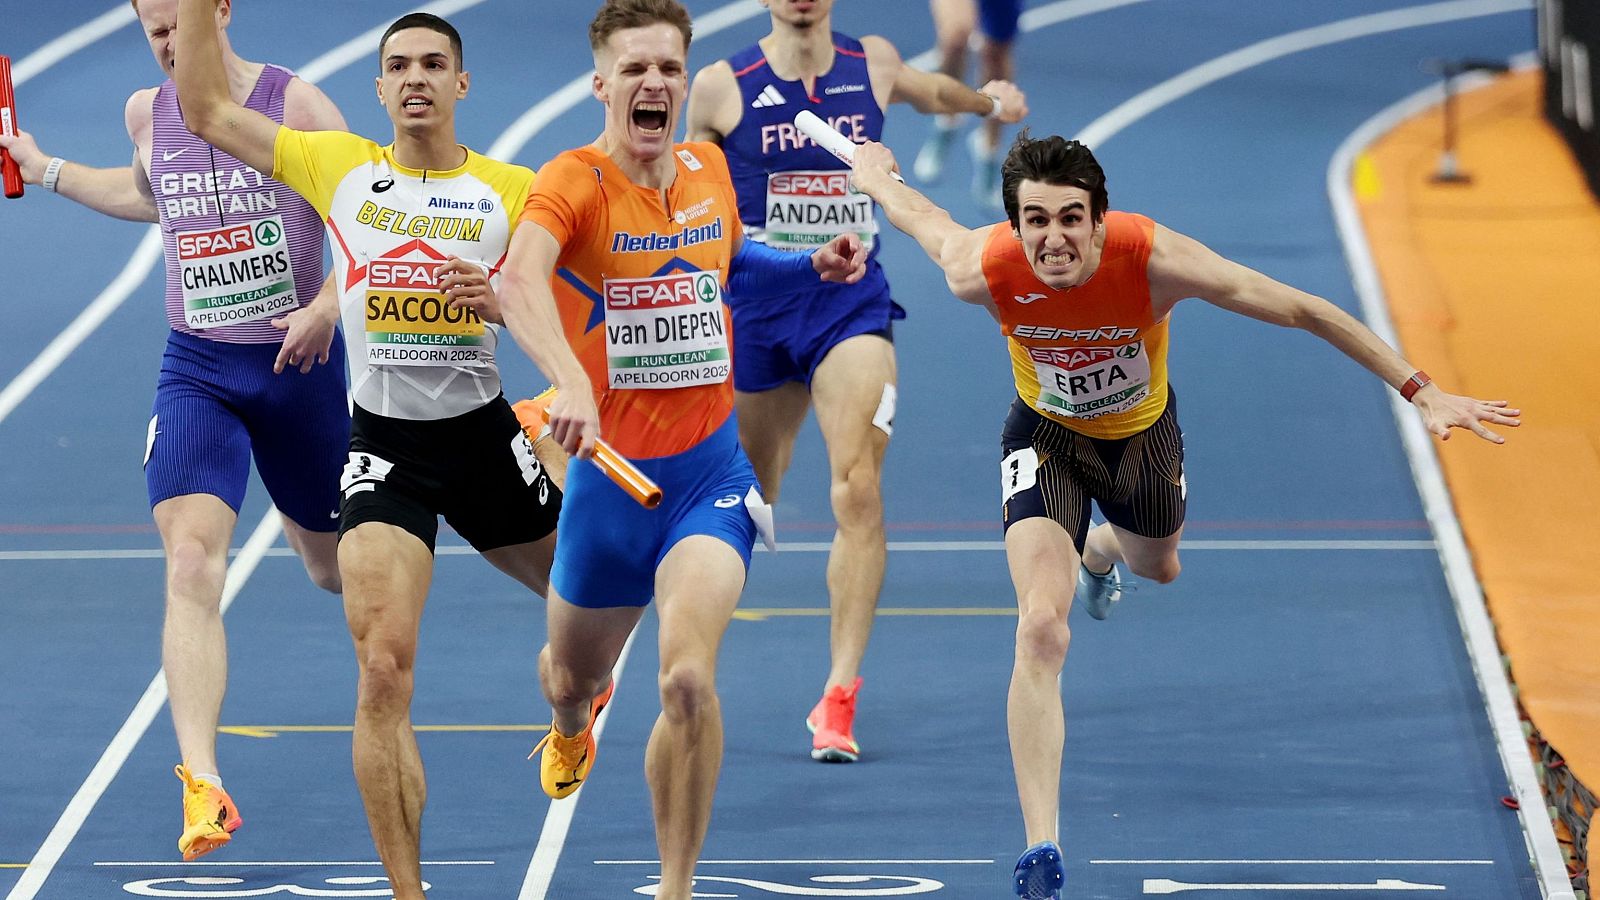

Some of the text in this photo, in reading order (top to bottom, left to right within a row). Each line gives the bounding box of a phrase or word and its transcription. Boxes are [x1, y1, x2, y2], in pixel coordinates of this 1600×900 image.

[761, 114, 868, 154] FRACE
[772, 176, 845, 194] SPAR
[165, 191, 277, 219] BRITAIN
[428, 197, 475, 210] Allianz
[769, 201, 867, 225] ANDANT
[356, 200, 484, 242] BELGIUM
[179, 230, 252, 256] SPAR
[610, 216, 723, 253] Nederland
[184, 251, 288, 290] CHALMERS
[210, 295, 233, 307] RUN
[609, 281, 694, 307] SPAR
[190, 294, 294, 324] APELDOORN 2025
[393, 333, 418, 344] RUN
[608, 310, 722, 345] van DIEPEN
[1012, 324, 1139, 342] ESPAÑA
[369, 348, 478, 362] APELDOORN 2025
[641, 356, 667, 366] RUN
[1030, 350, 1112, 368] SPAR
[613, 365, 728, 384] APELDOORN 2025
[1055, 365, 1128, 397] ERTA
